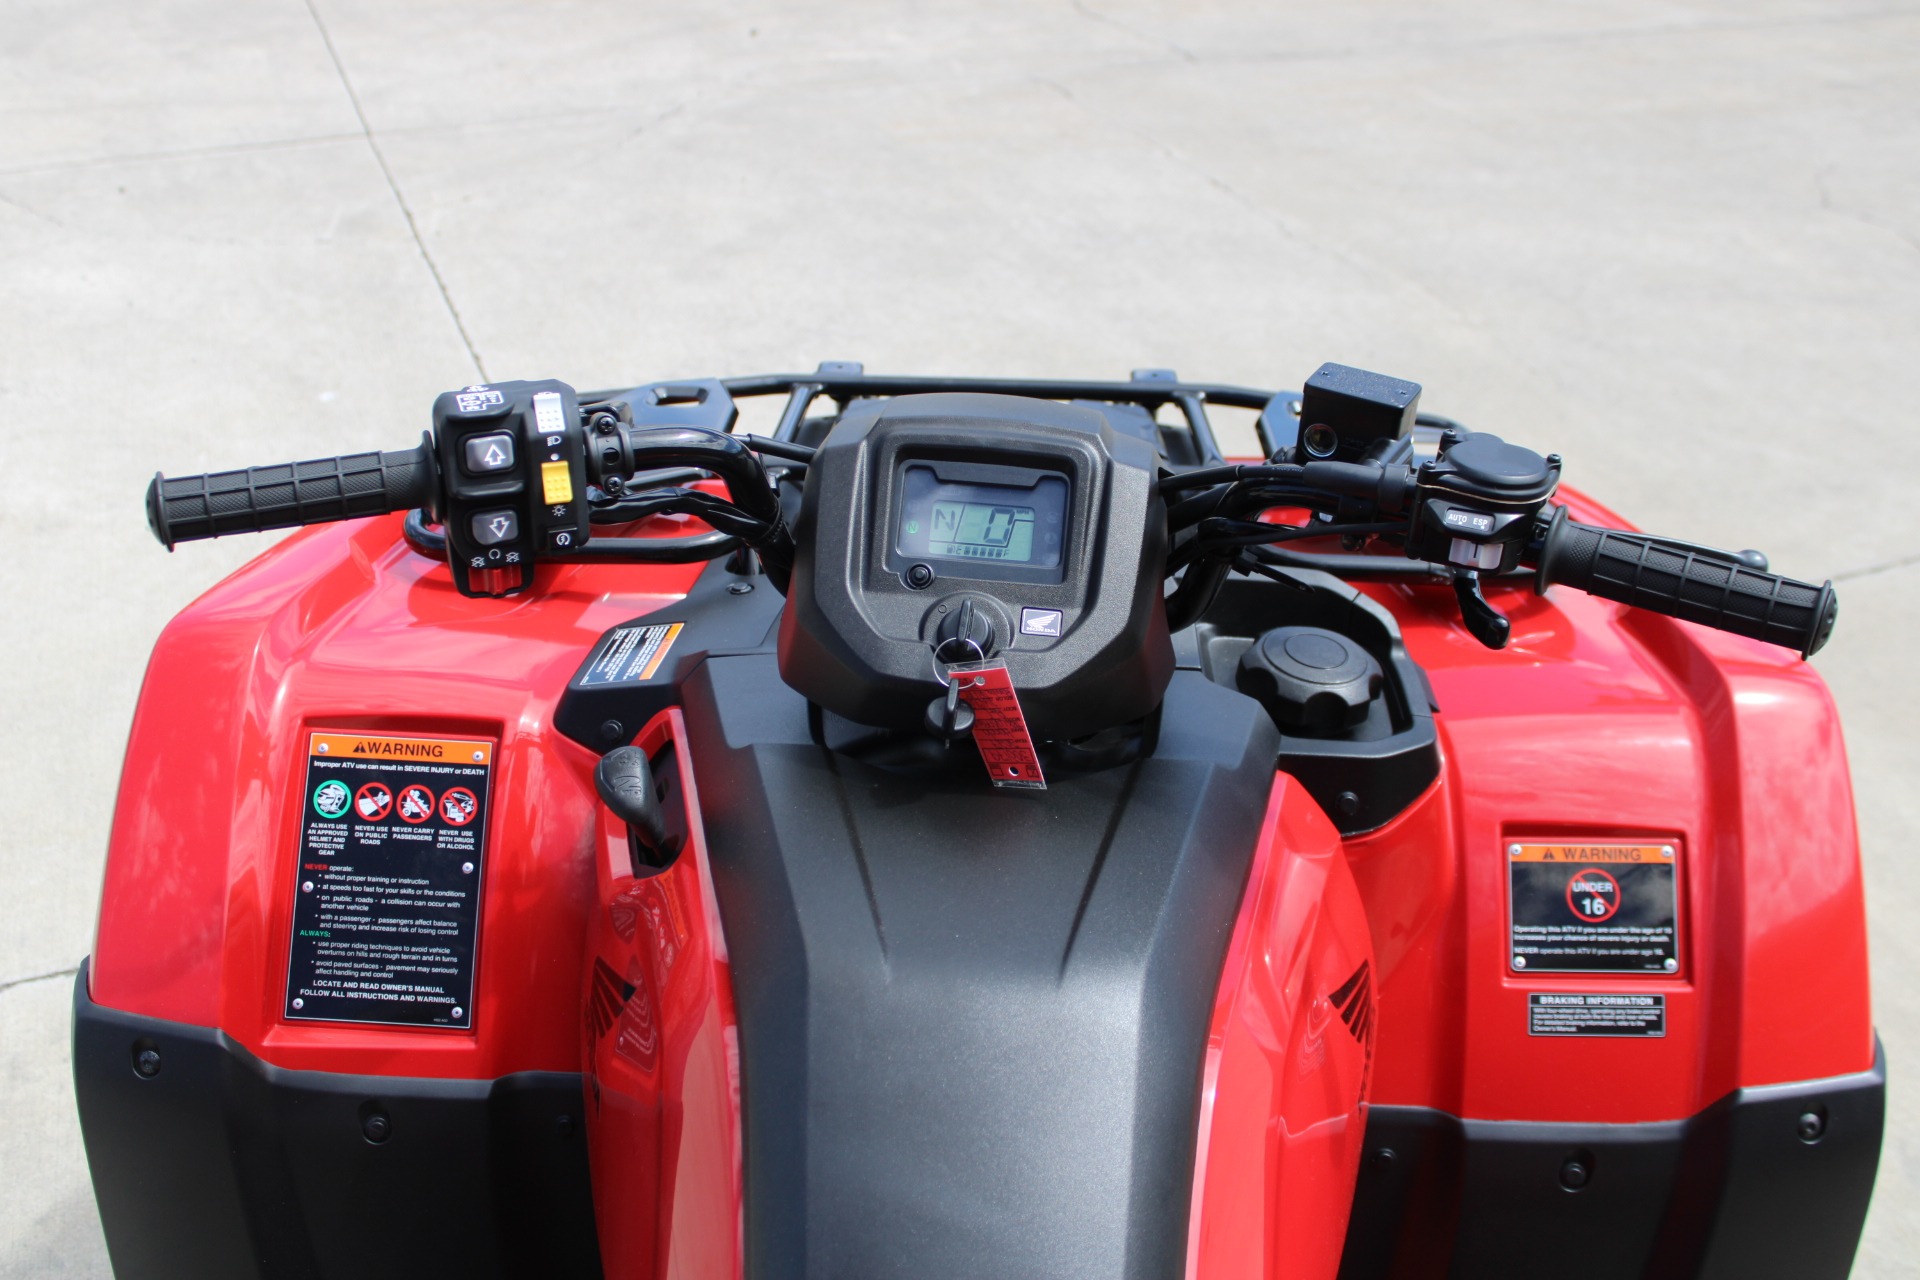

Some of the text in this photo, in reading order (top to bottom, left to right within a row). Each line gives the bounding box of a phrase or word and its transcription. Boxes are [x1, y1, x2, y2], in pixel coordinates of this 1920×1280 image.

[934, 508, 956, 530] N
[984, 508, 1015, 544] 0
[1448, 514, 1488, 526] AUTO ESP
[367, 742, 443, 756] WARNING
[1563, 848, 1641, 860] WARNING
[1572, 882, 1612, 892] UNDER
[1582, 898, 1605, 914] 16
[346, 991, 398, 1000] INSTRUCTIONS
